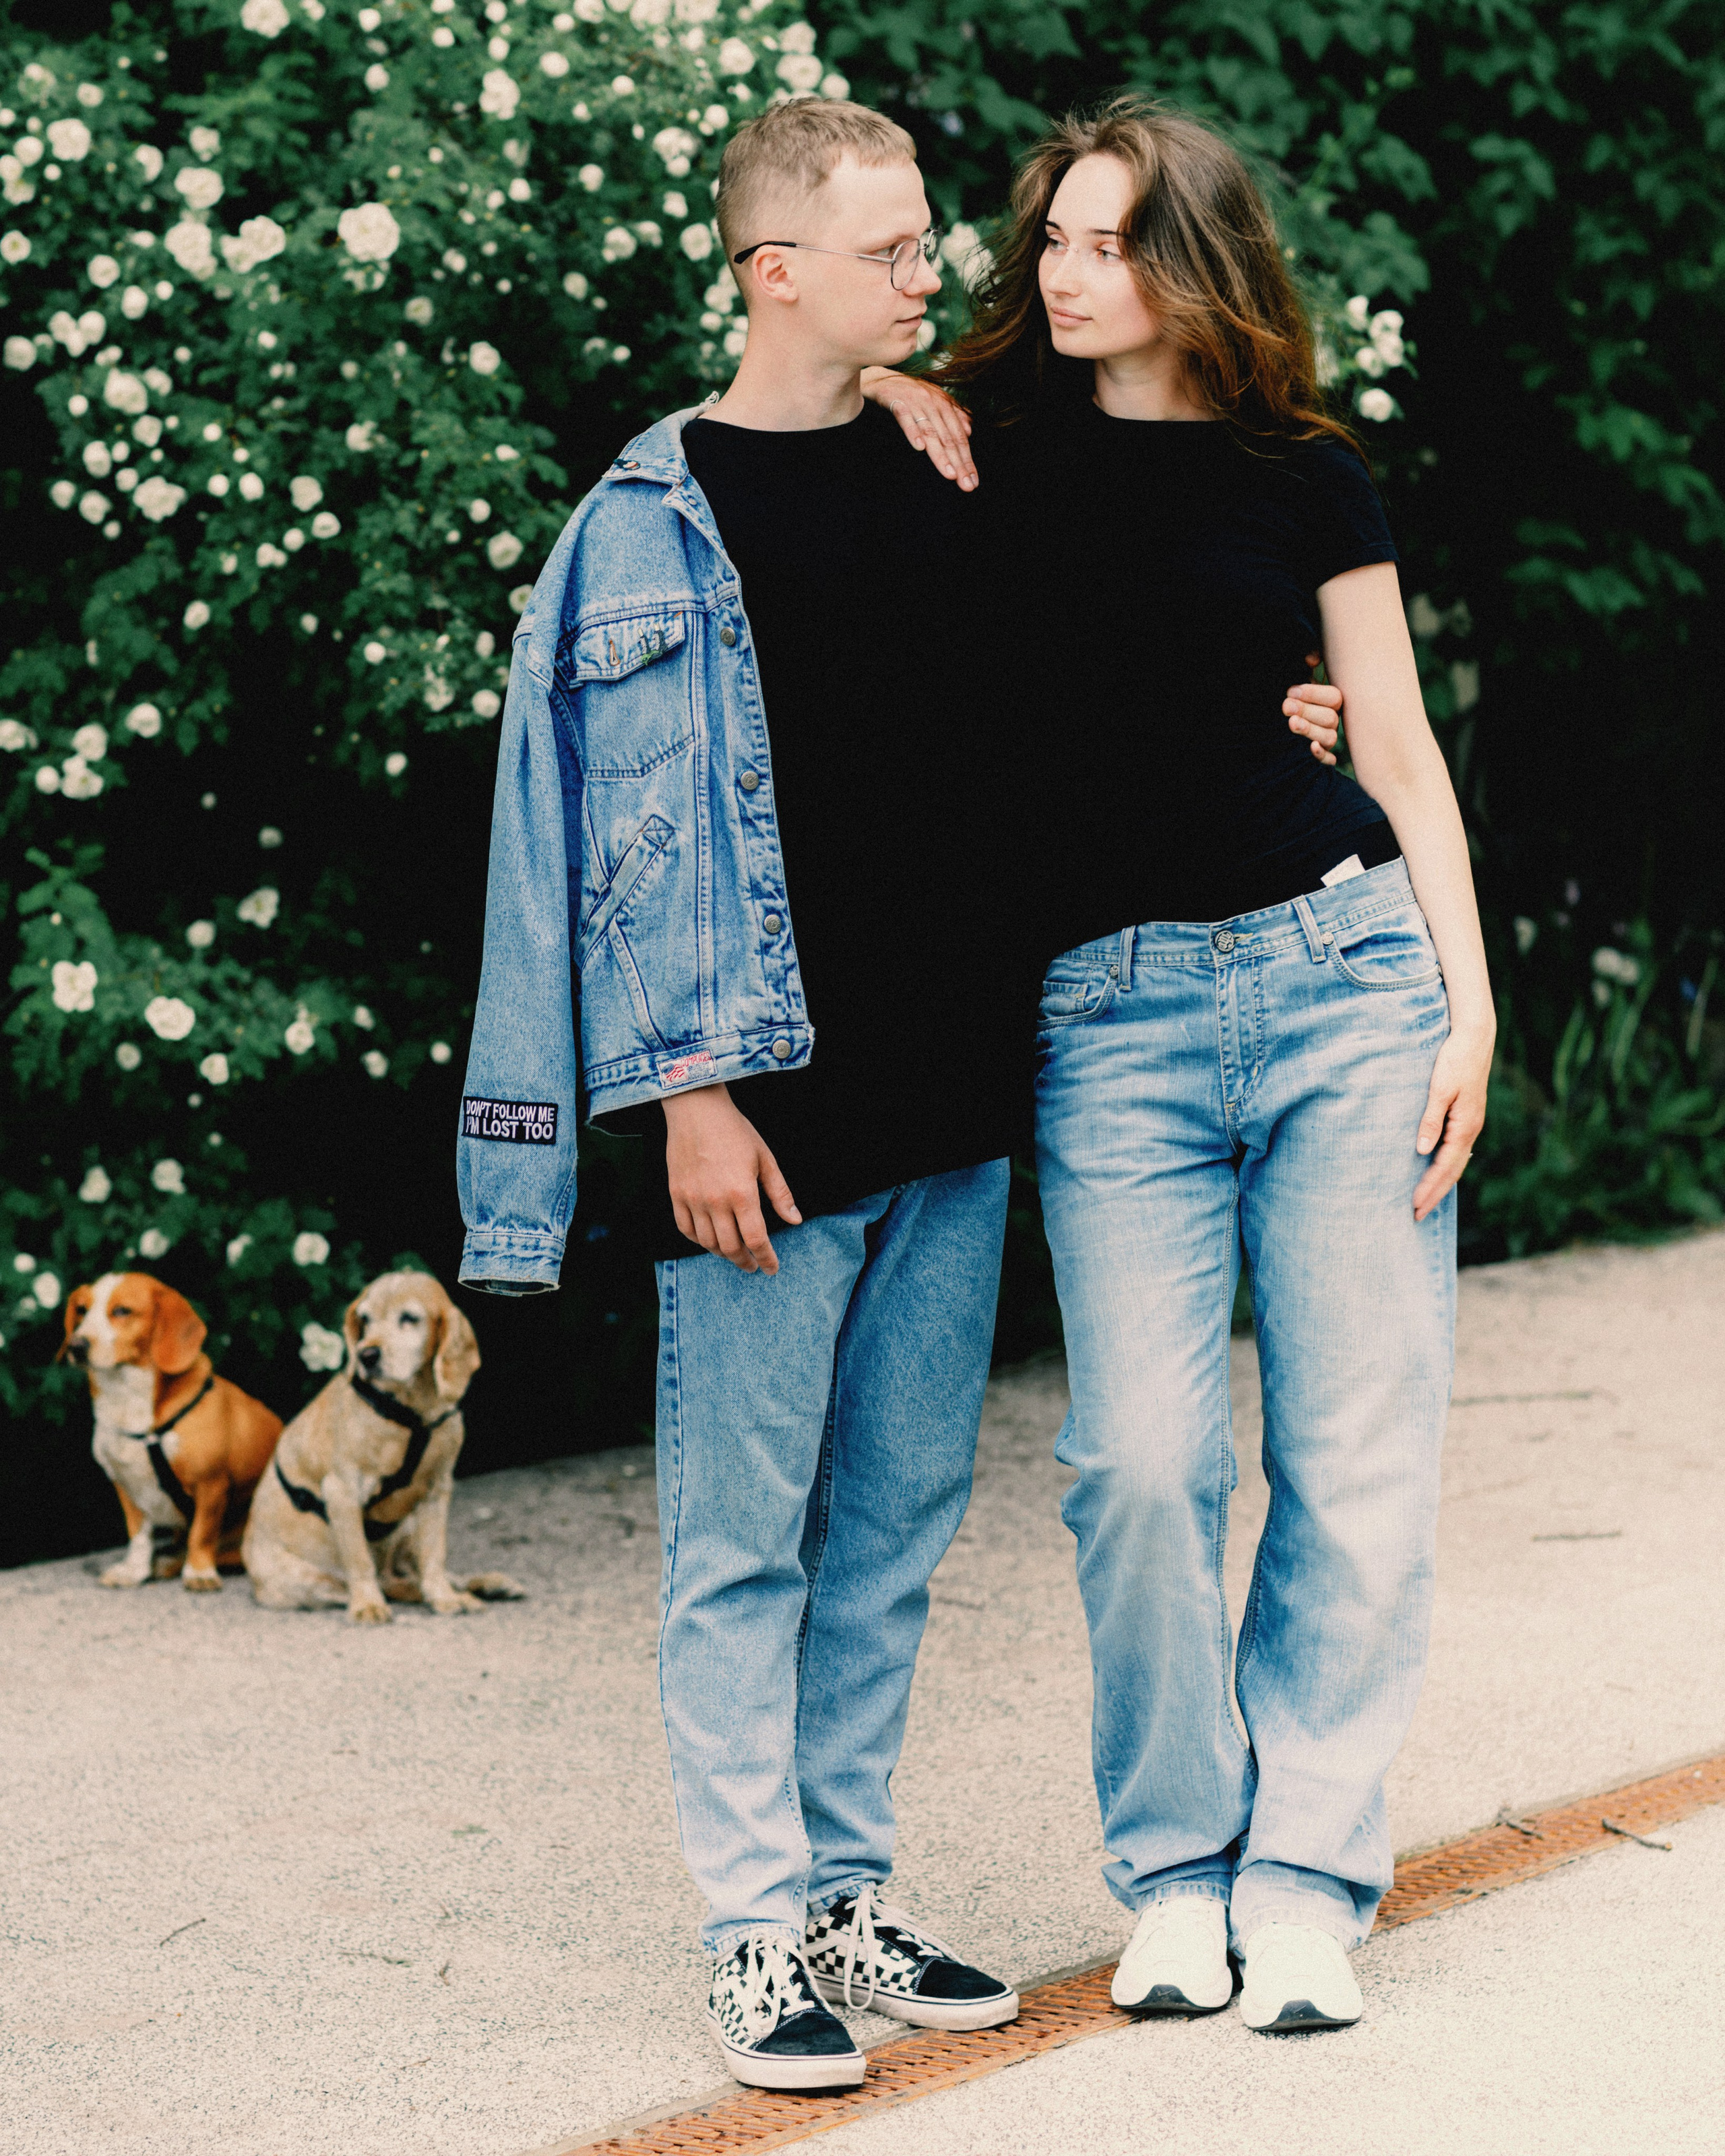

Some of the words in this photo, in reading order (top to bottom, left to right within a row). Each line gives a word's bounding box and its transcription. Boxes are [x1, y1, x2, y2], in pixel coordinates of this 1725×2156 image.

[466, 1100, 491, 1118] DON'T
[493, 1104, 536, 1122] FOLLOW
[538, 1106, 555, 1122] ME
[466, 1116, 479, 1135] I'M
[482, 1118, 519, 1139] LOST
[523, 1122, 553, 1139] TOO
